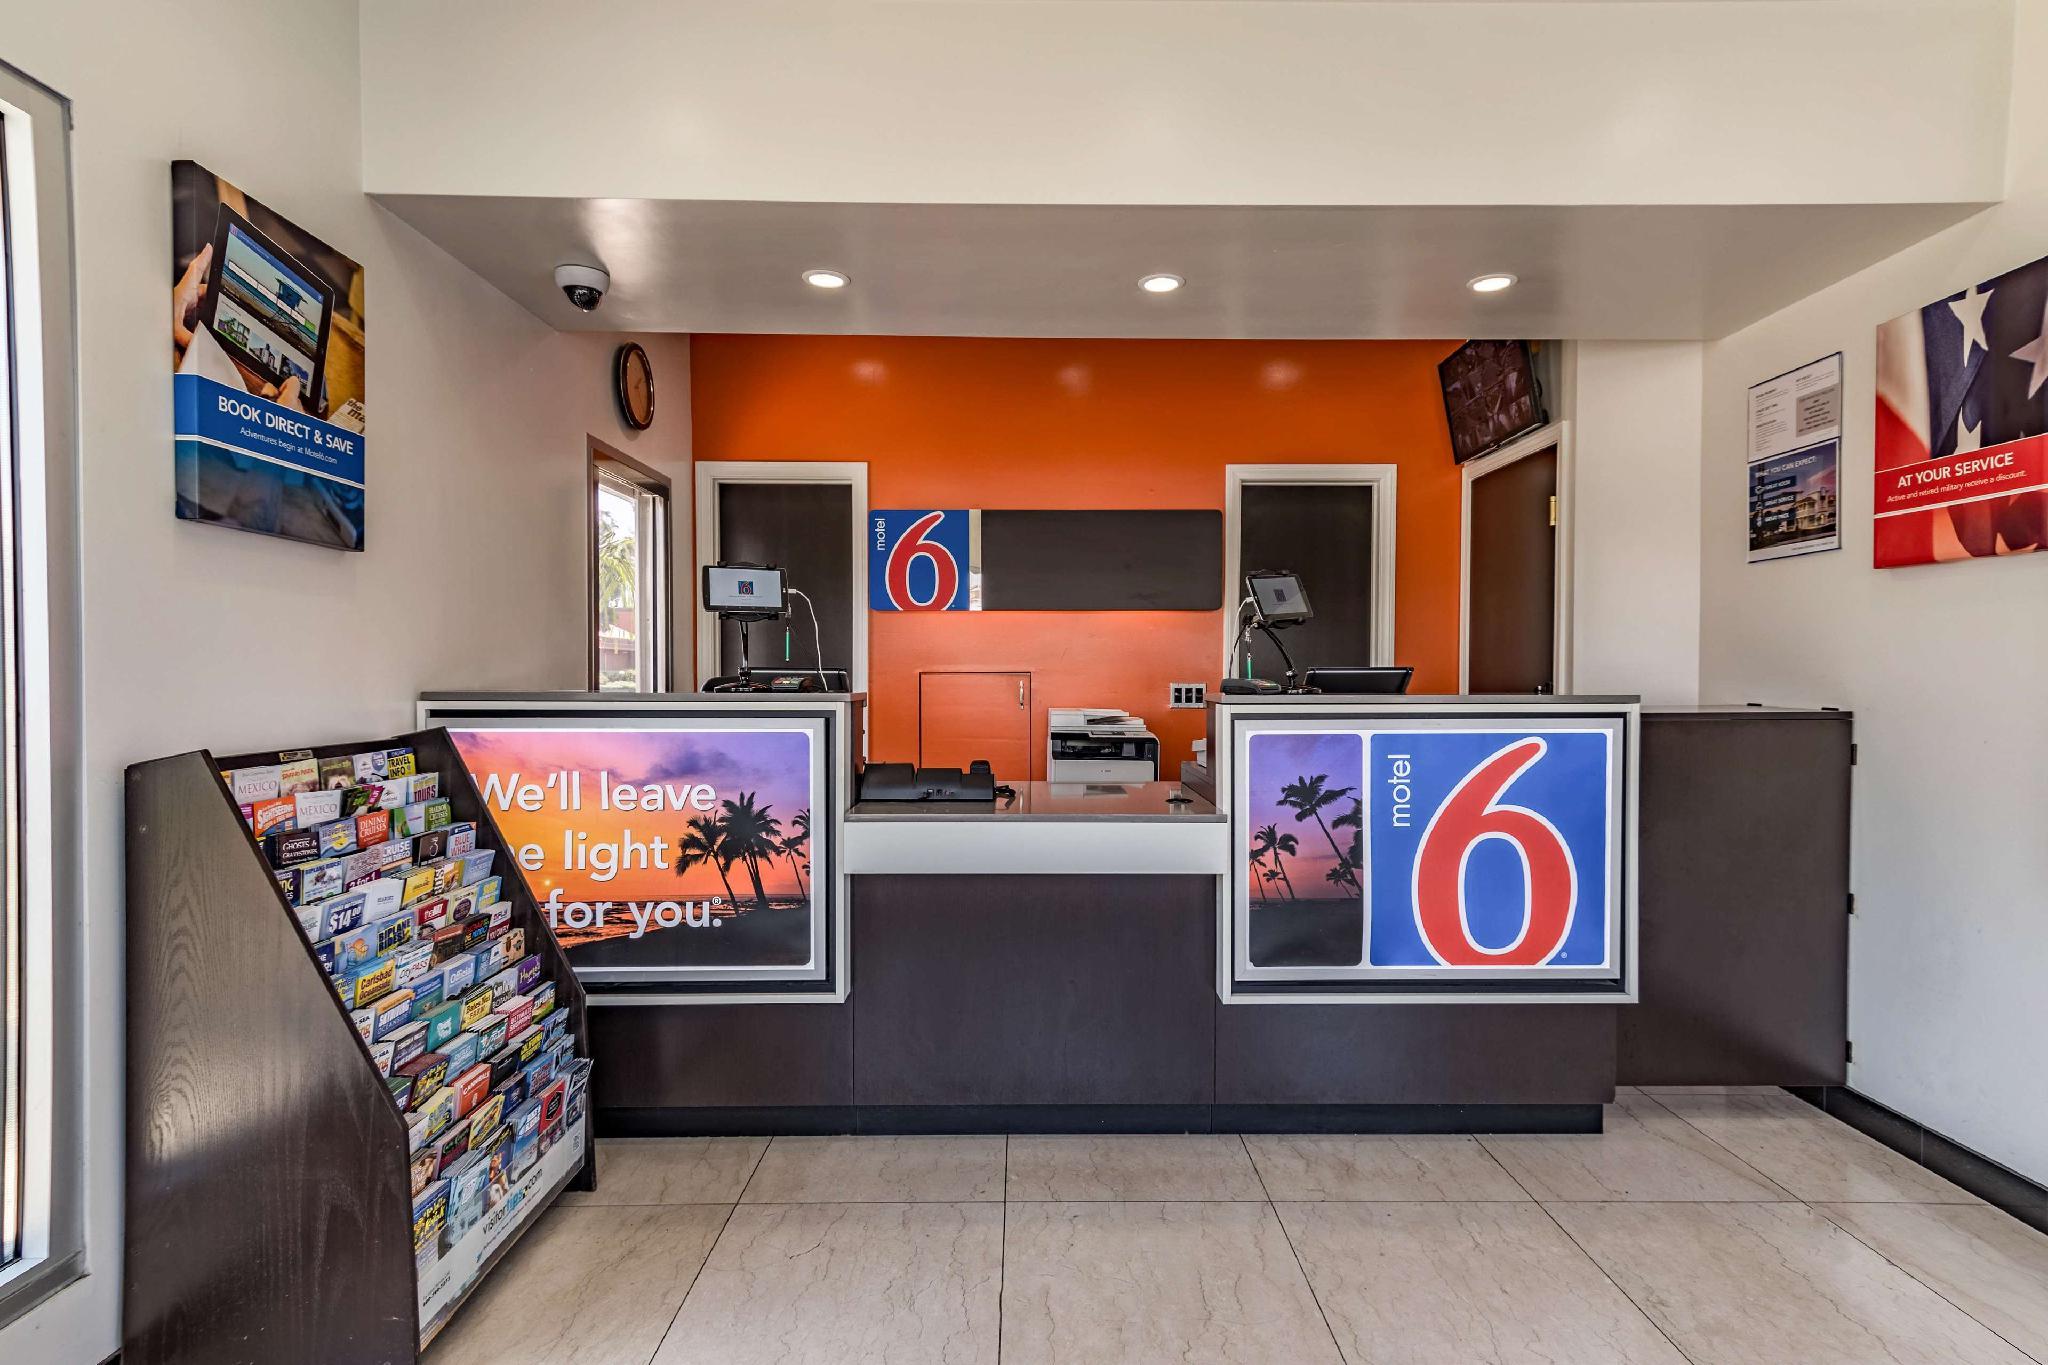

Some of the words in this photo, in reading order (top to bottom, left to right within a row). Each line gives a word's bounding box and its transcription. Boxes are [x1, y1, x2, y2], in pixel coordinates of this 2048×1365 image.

[218, 395, 262, 424] BOOK
[265, 412, 311, 440] DIRECT
[313, 429, 323, 445] &
[325, 433, 354, 456] SAVE
[239, 426, 278, 446] Adventures
[278, 438, 296, 451] begin
[297, 446, 304, 454] at
[304, 447, 338, 464] Motel6.com
[1781, 462, 1794, 471] CAN
[1897, 474, 1913, 488] AT
[1915, 466, 1951, 484] YOUR
[1954, 452, 2014, 476] SERVICE
[1886, 495, 1906, 503] Active
[1906, 490, 1918, 499] and
[1918, 486, 1939, 497] retired
[1940, 482, 1964, 493] military
[1964, 477, 1989, 487] receive
[874, 518, 885, 551] motel
[884, 510, 959, 611] 6
[387, 756, 411, 768] TRAVEL
[389, 767, 406, 779] INFO
[238, 780, 278, 794] MEXICO
[413, 784, 436, 803] TOURS
[601, 770, 716, 811] leave
[1387, 754, 1411, 828] motel
[299, 803, 338, 816] MEXICO
[359, 815, 387, 829] DINING
[359, 823, 387, 838] CRUISES
[282, 840, 310, 851] GHOSTS
[384, 839, 411, 856] CRUISE
[564, 829, 669, 882] light
[1411, 736, 1578, 967] 6
[544, 889, 612, 930] for
[360, 966, 394, 990] Carlsbad
